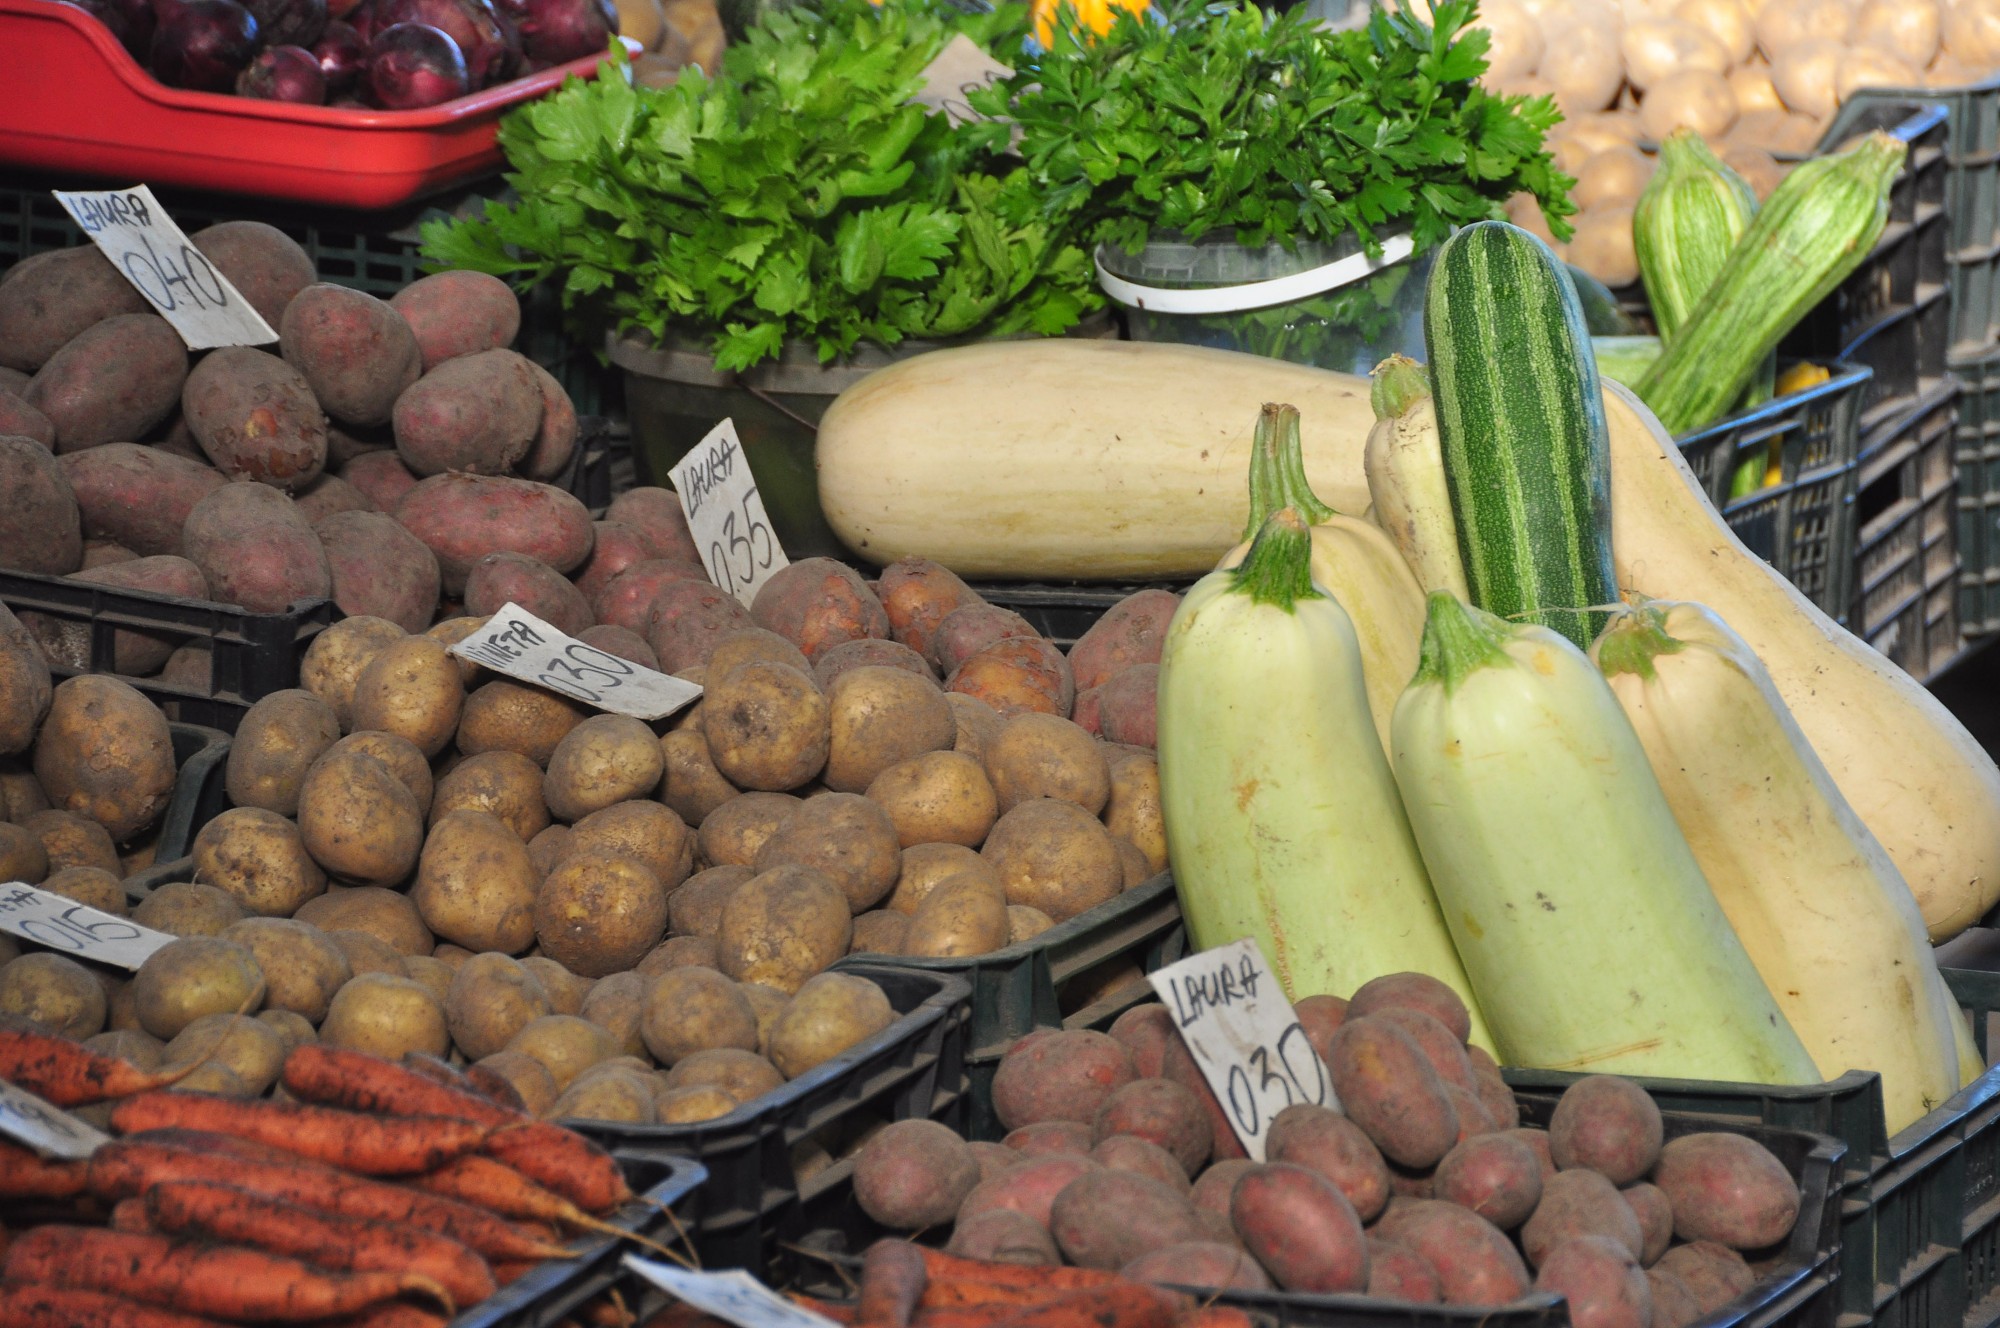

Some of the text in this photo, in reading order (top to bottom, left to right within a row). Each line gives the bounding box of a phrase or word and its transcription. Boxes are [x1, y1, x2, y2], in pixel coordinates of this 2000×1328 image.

[69, 193, 152, 232] LAURA
[682, 437, 738, 520] LAURA
[1169, 953, 1264, 1028] LAURA
